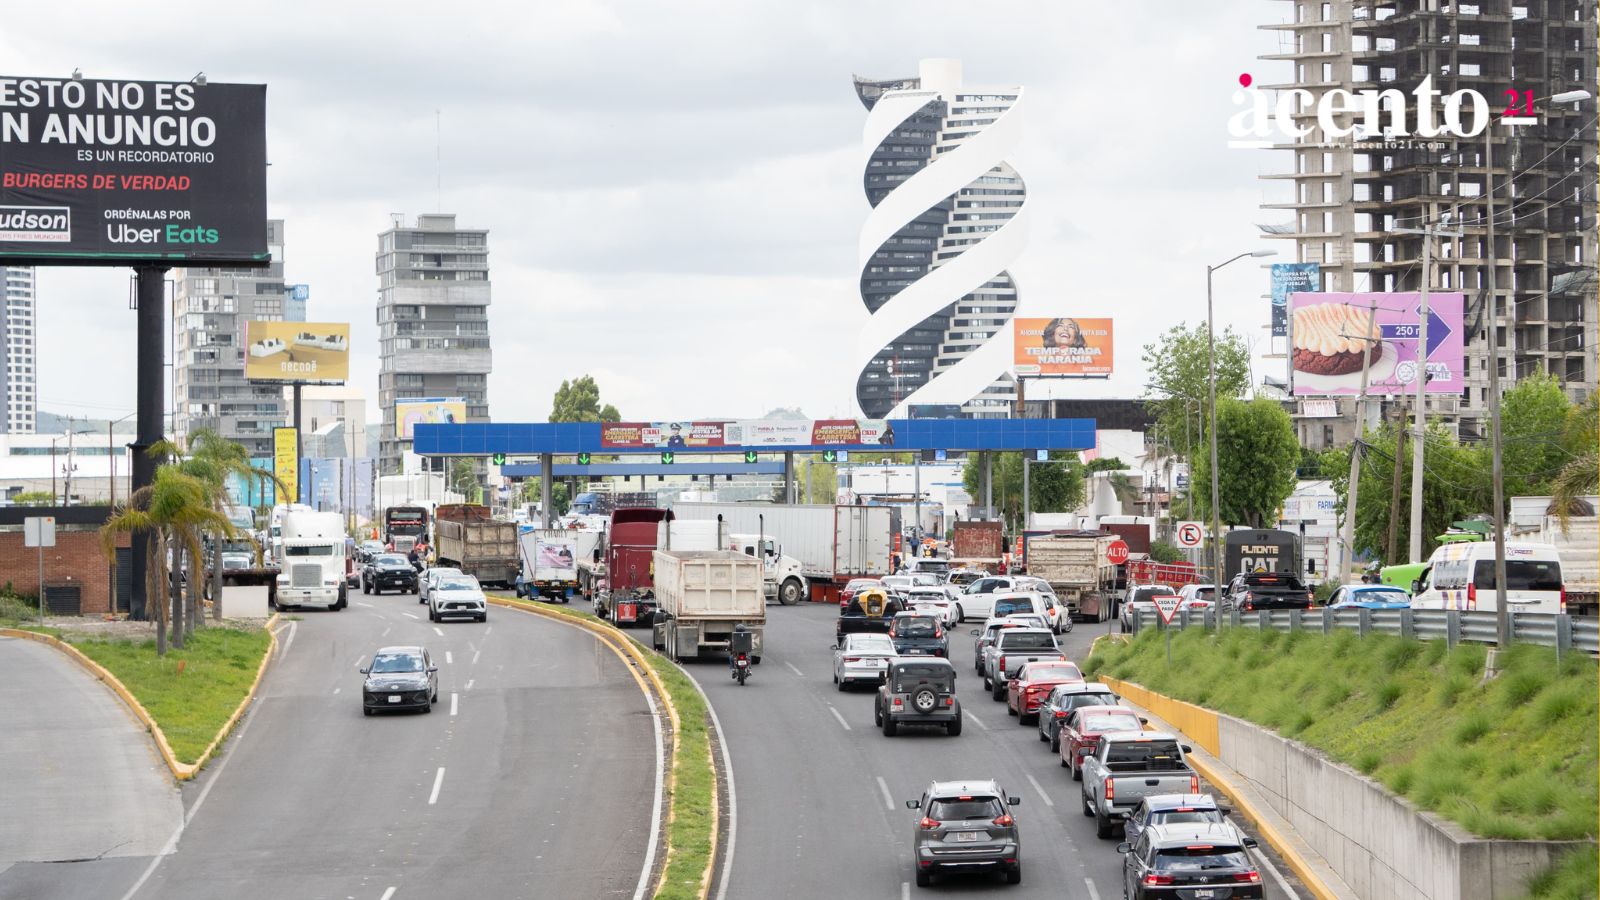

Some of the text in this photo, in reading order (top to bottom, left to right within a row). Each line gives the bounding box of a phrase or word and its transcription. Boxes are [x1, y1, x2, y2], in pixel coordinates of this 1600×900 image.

[0, 79, 195, 111] ESTO NO ES
[41, 113, 216, 147] ANUNCIO
[77, 149, 214, 163] ES UN RECORDATORIO
[3, 172, 191, 191] BURGERS DE VERDAD
[104, 208, 191, 220] ORDÉNALAS POR
[106, 223, 219, 244] Uber Eats
[1395, 326, 1414, 336] 250
[1107, 547, 1128, 557] ALTO
[1240, 557, 1279, 573] CAT
